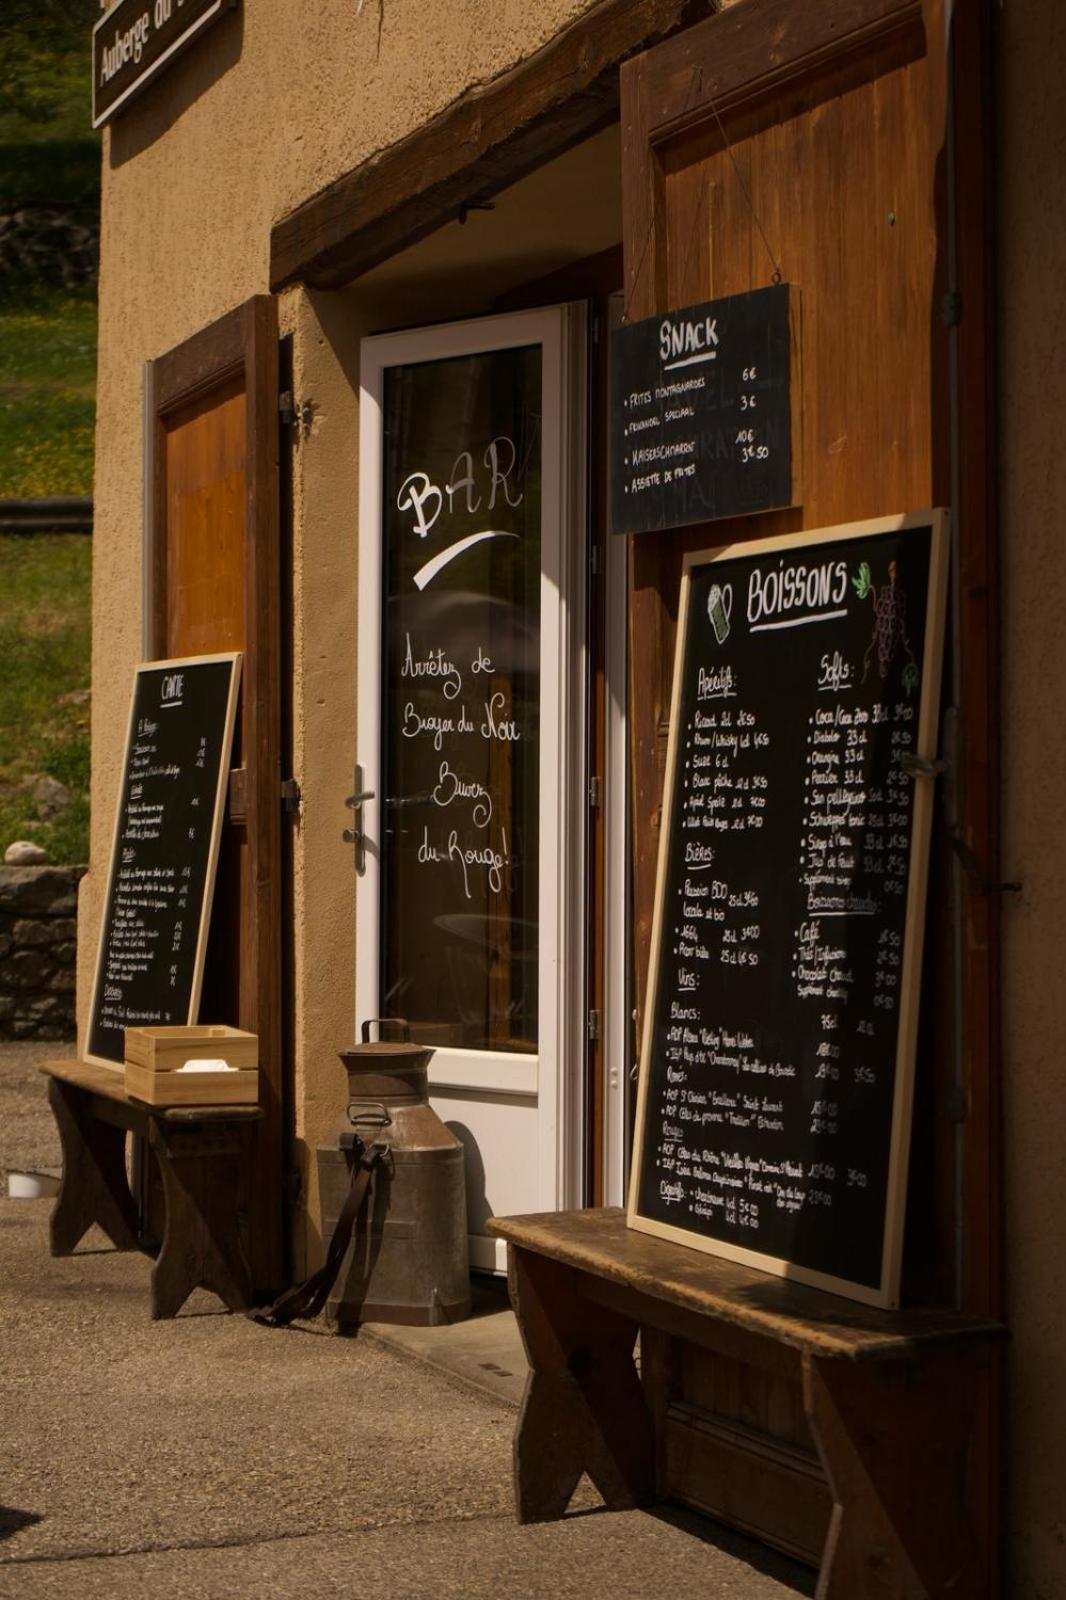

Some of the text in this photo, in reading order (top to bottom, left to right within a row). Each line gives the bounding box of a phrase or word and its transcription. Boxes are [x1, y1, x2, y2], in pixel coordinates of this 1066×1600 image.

[99, 11, 150, 87] Auberge
[659, 316, 720, 361] SNACK
[629, 388, 652, 411] FRITES
[742, 366, 758, 382] 6€
[740, 395, 757, 411] 3€
[735, 428, 755, 446] 10€
[397, 436, 524, 539] BAR
[631, 472, 661, 494] ASSIETTE
[664, 469, 674, 483] DE
[400, 631, 496, 700] Arrêtez de
[402, 692, 521, 751] Broyer du Noir
[433, 760, 493, 829] Buvez
[417, 825, 510, 899] du Rouge!
